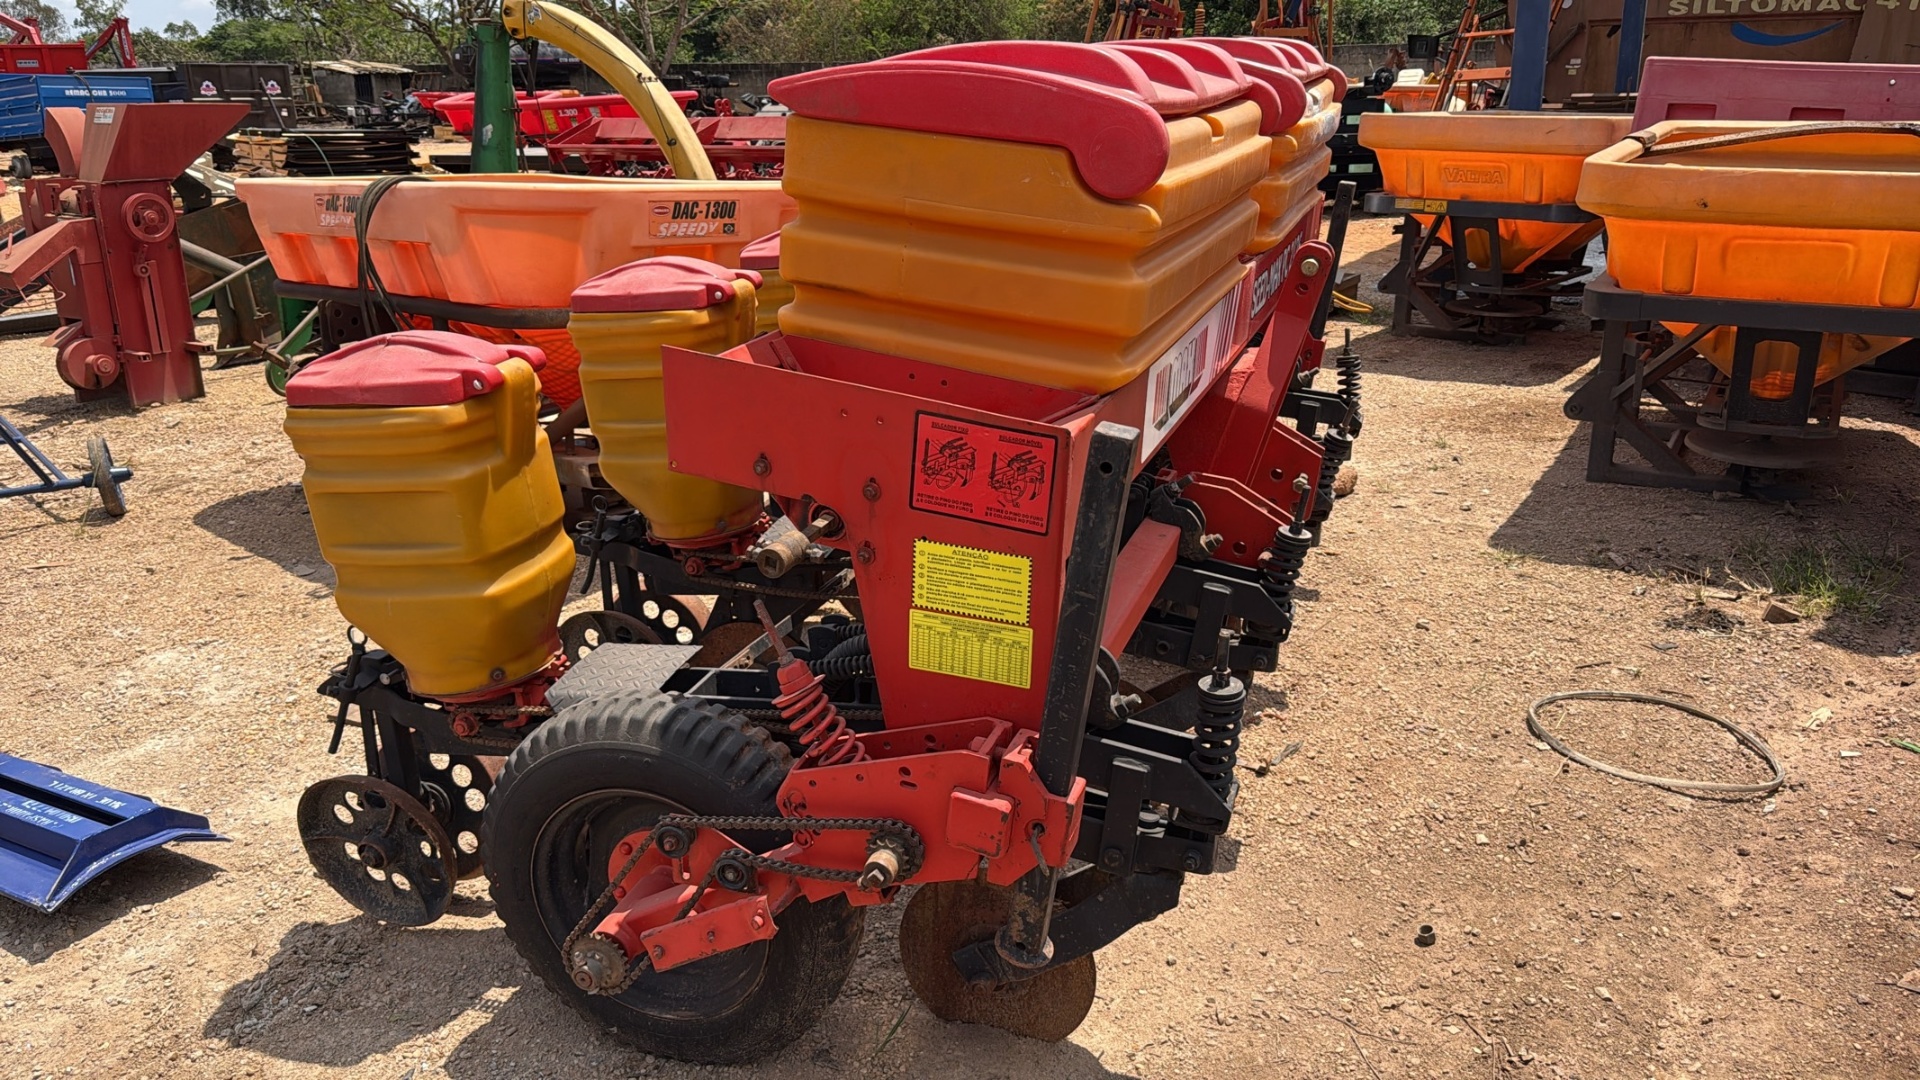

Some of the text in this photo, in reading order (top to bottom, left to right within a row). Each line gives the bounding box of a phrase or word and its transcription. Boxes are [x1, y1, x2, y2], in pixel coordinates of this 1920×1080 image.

[672, 202, 736, 220] DAC-1300
[656, 222, 719, 238] SPEEDY
[924, 499, 946, 507] COLOQUE
[993, 513, 1016, 522] COLOQUE
[951, 548, 988, 560] ATENÇÃO
